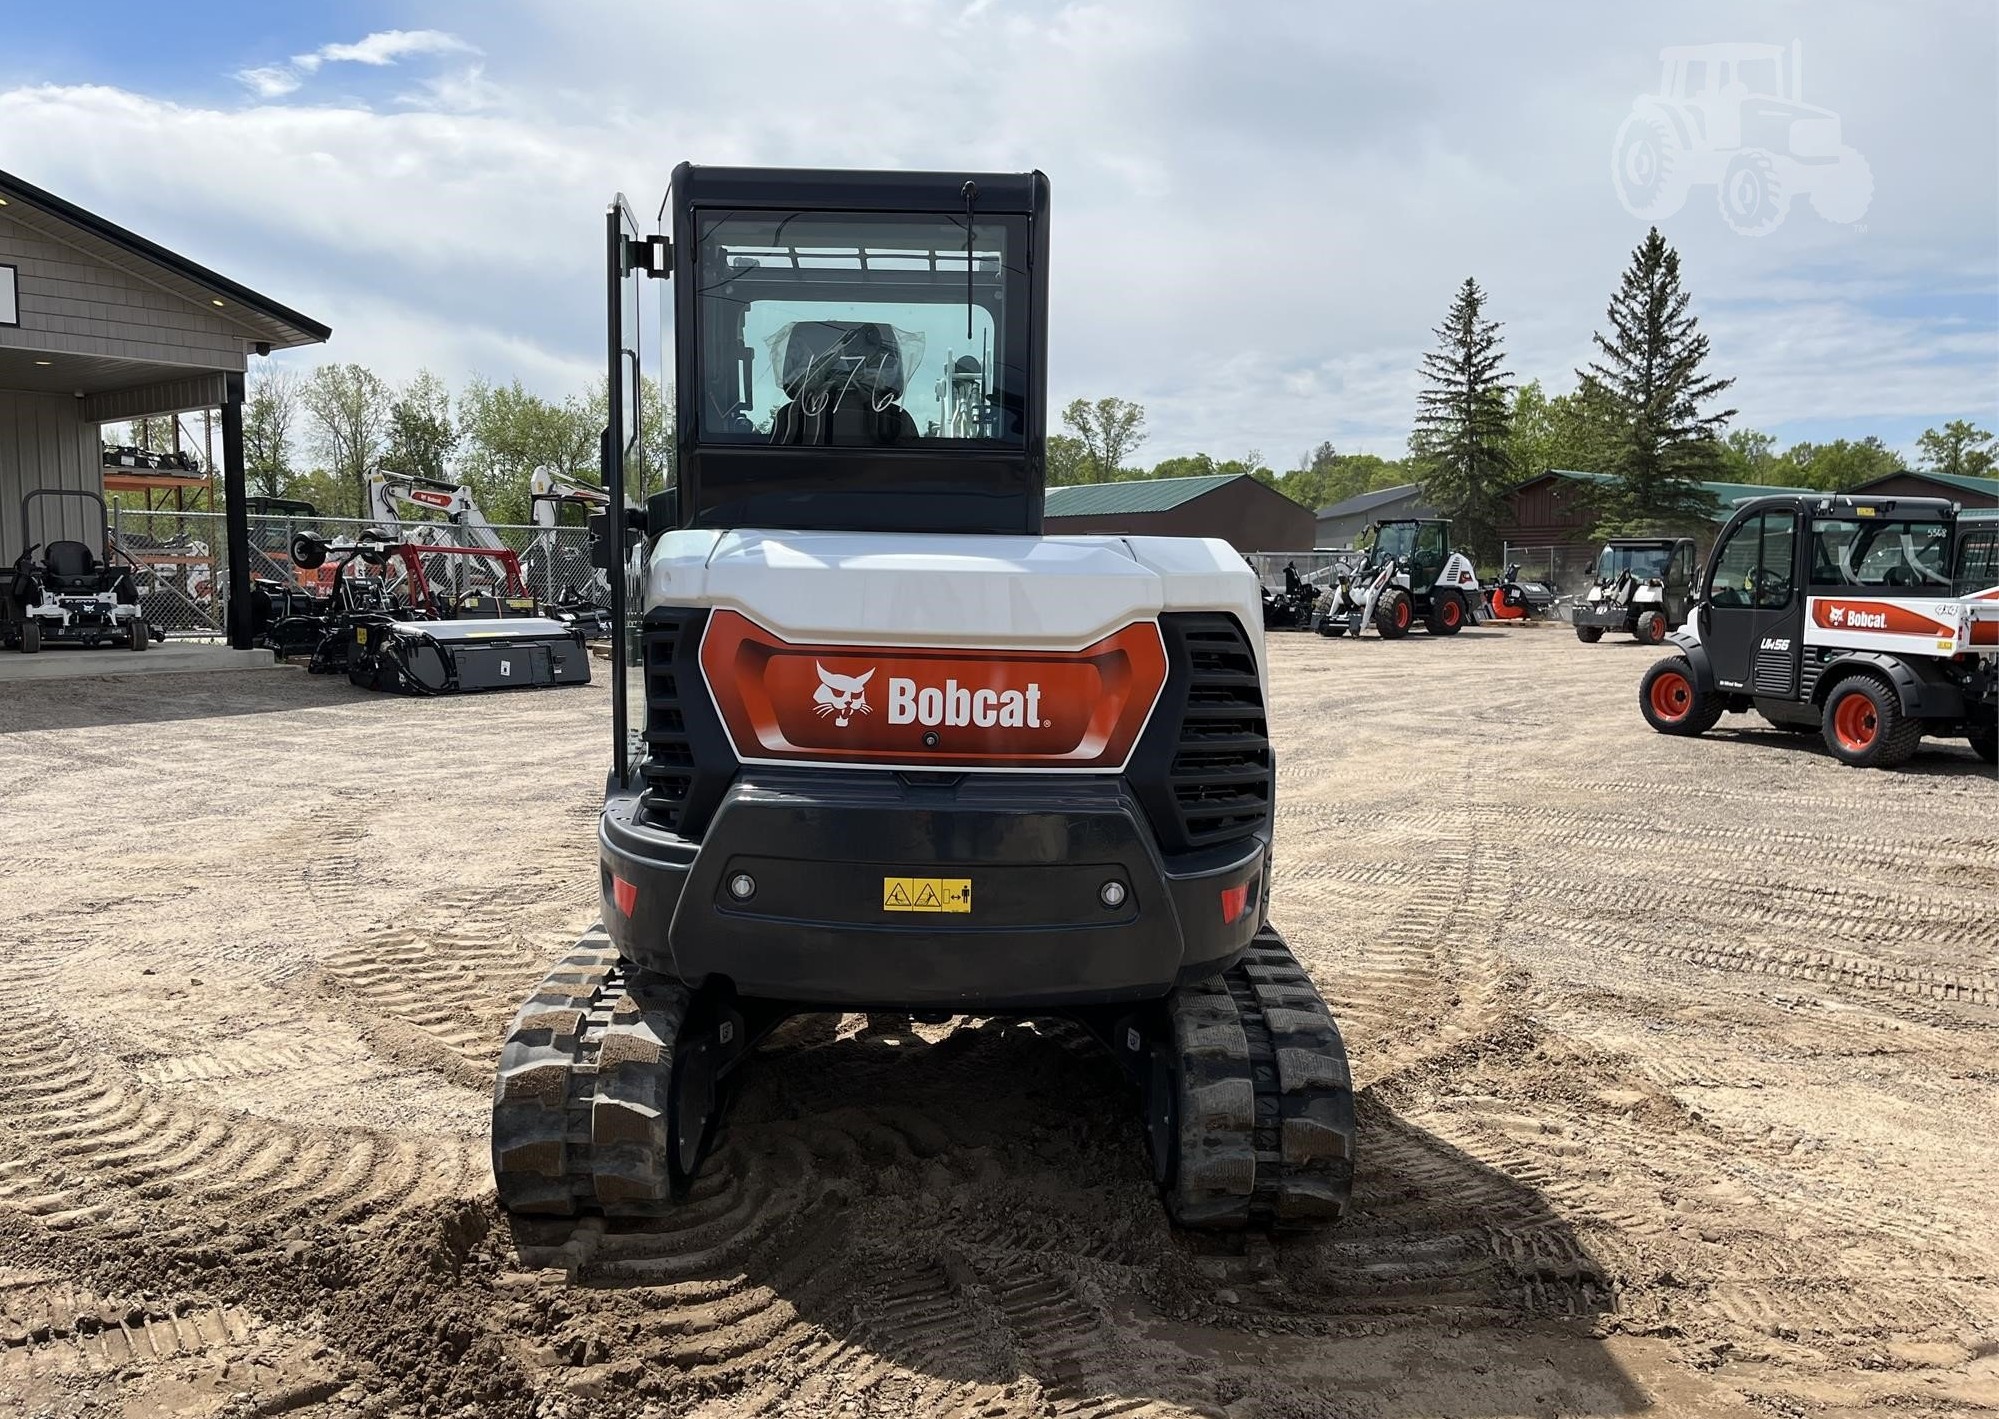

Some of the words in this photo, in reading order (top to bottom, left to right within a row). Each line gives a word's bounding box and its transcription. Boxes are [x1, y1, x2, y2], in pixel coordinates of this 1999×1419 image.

[1847, 610, 1886, 628] Bobcat
[1760, 638, 1790, 650] UW56
[888, 677, 1041, 728] Bobcat
